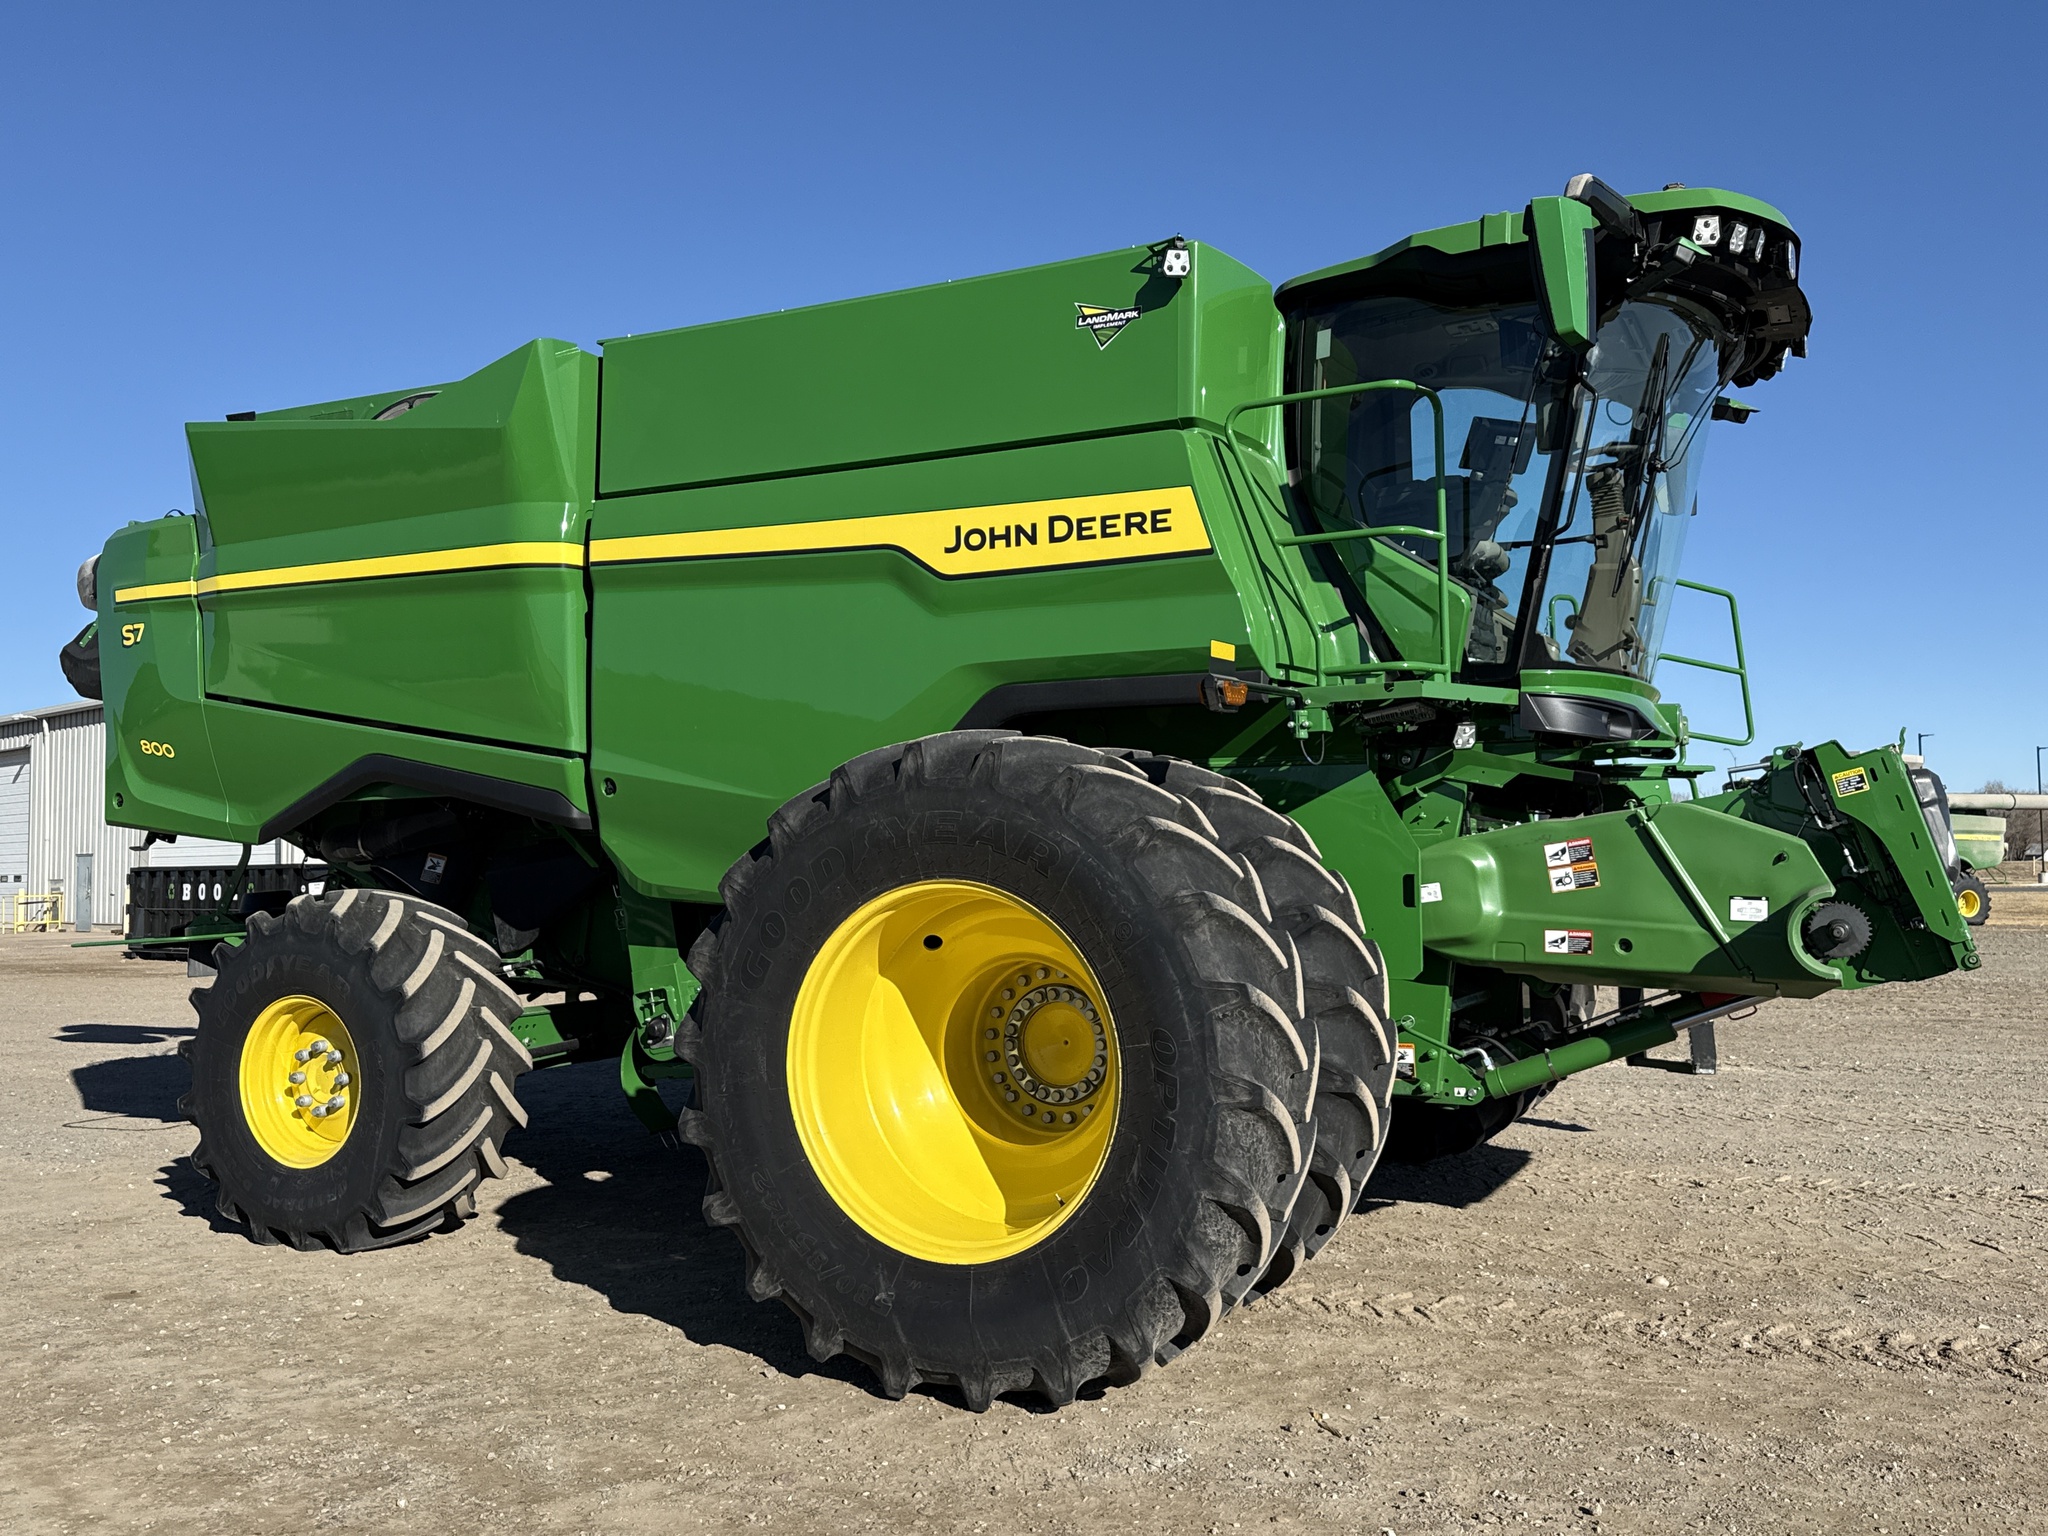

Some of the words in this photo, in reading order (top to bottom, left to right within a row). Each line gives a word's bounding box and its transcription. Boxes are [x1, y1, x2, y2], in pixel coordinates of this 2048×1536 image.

[1078, 310, 1139, 326] LANDMARK
[1093, 320, 1127, 329] IMPLEMENT
[944, 523, 1038, 554] JOHN
[1048, 508, 1172, 544] DEERE
[121, 622, 145, 647] S7
[139, 739, 176, 759] 800
[181, 882, 239, 901] BOO
